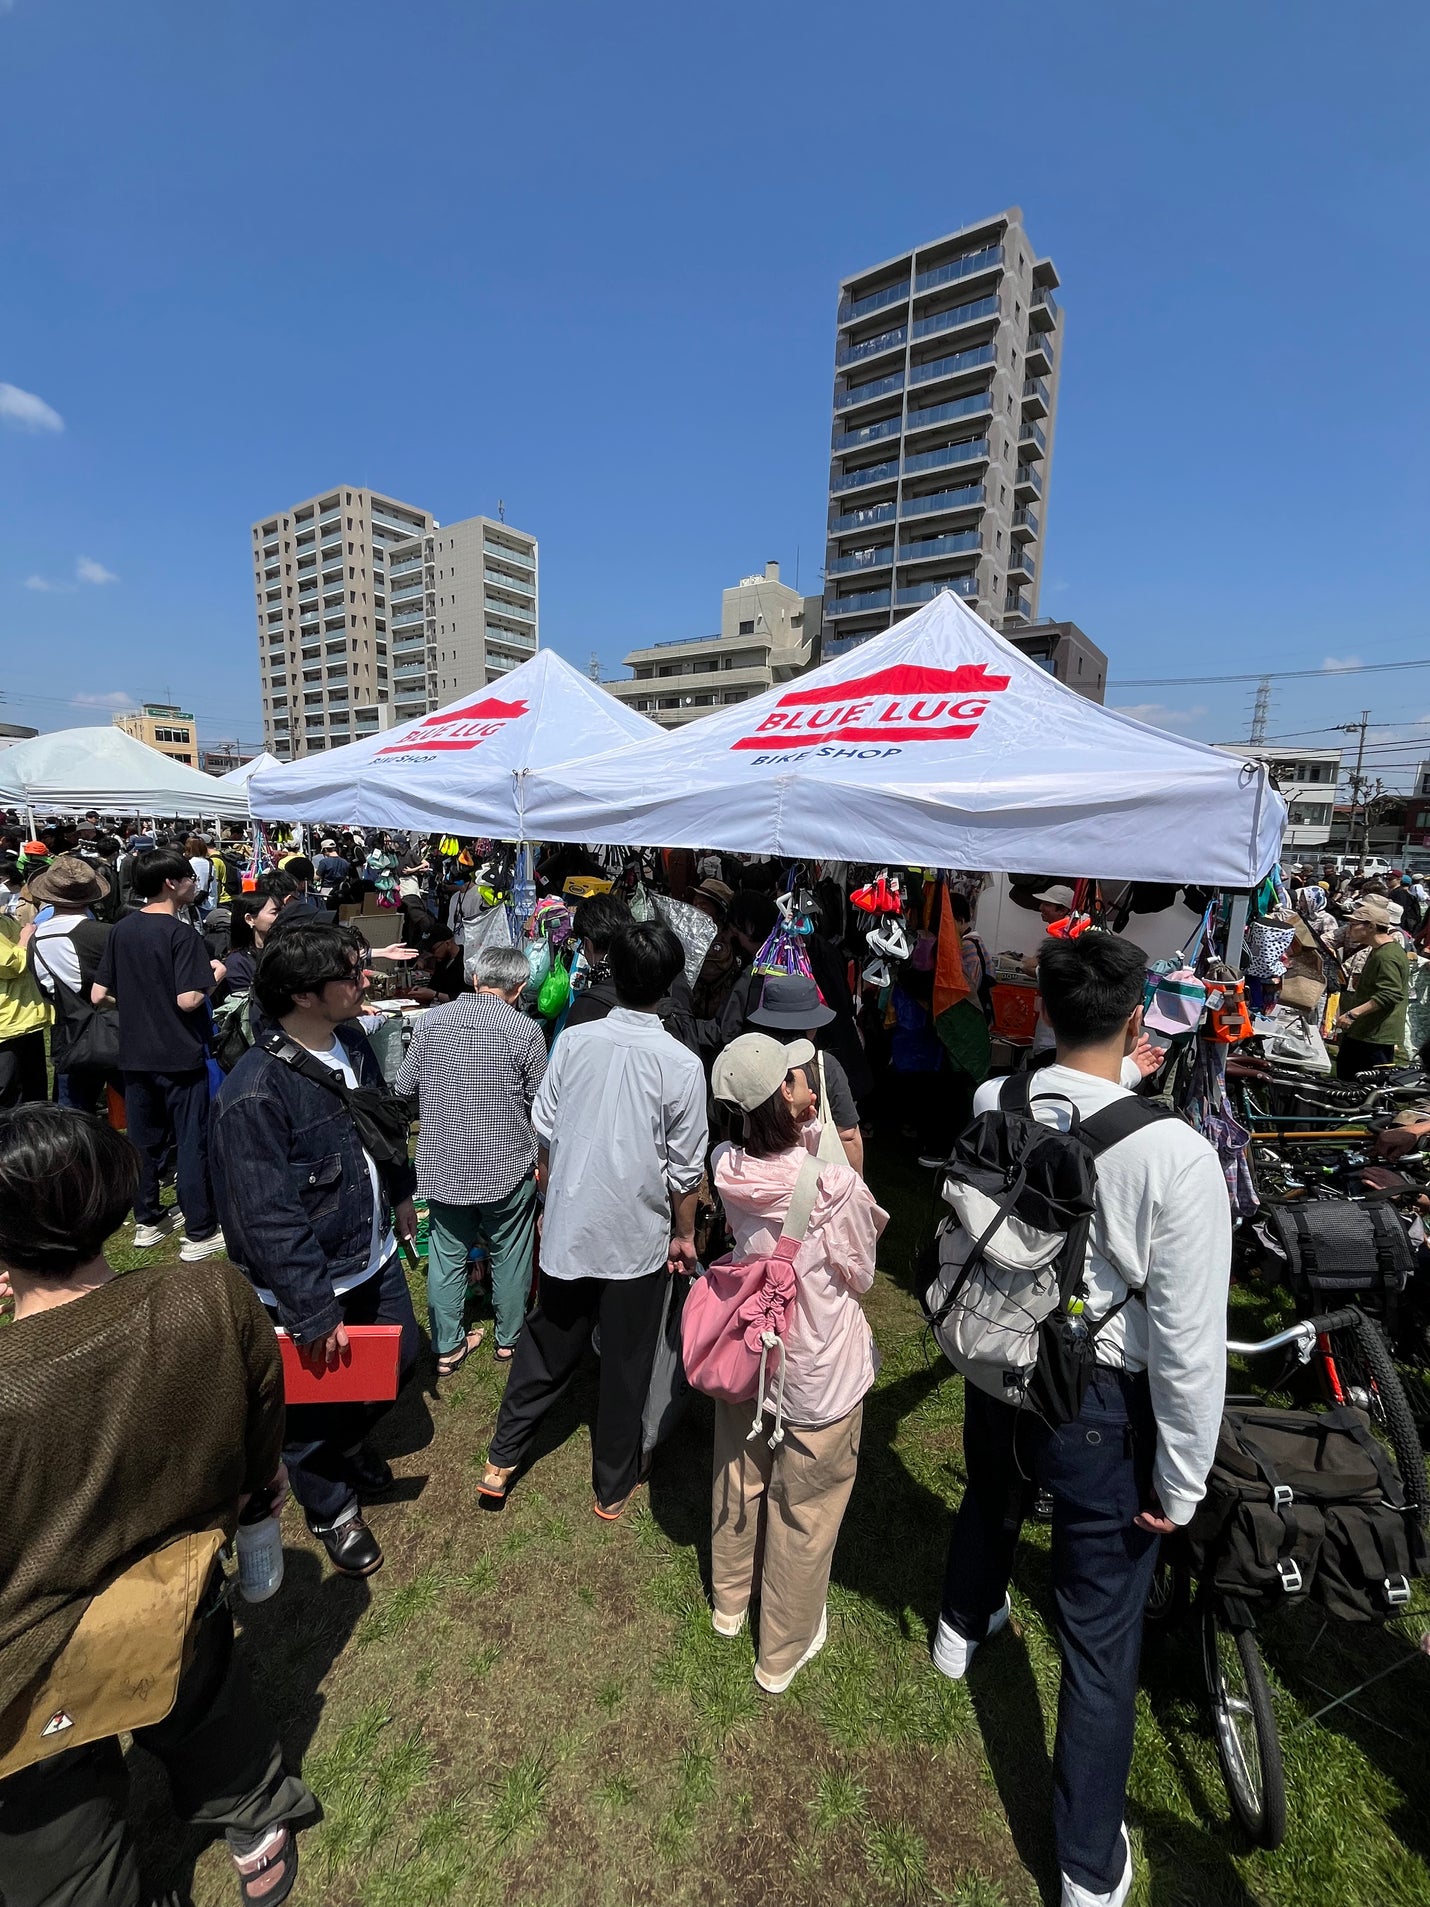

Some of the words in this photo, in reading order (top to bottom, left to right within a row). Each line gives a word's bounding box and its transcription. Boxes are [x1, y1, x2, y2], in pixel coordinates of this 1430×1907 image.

[754, 702, 875, 732] BLUE
[878, 699, 992, 722] LUG
[395, 722, 458, 743] BLUE
[448, 722, 507, 737] LUG
[395, 755, 438, 763] SHOP
[750, 751, 811, 765] BIKE
[815, 747, 903, 759] SHOP
